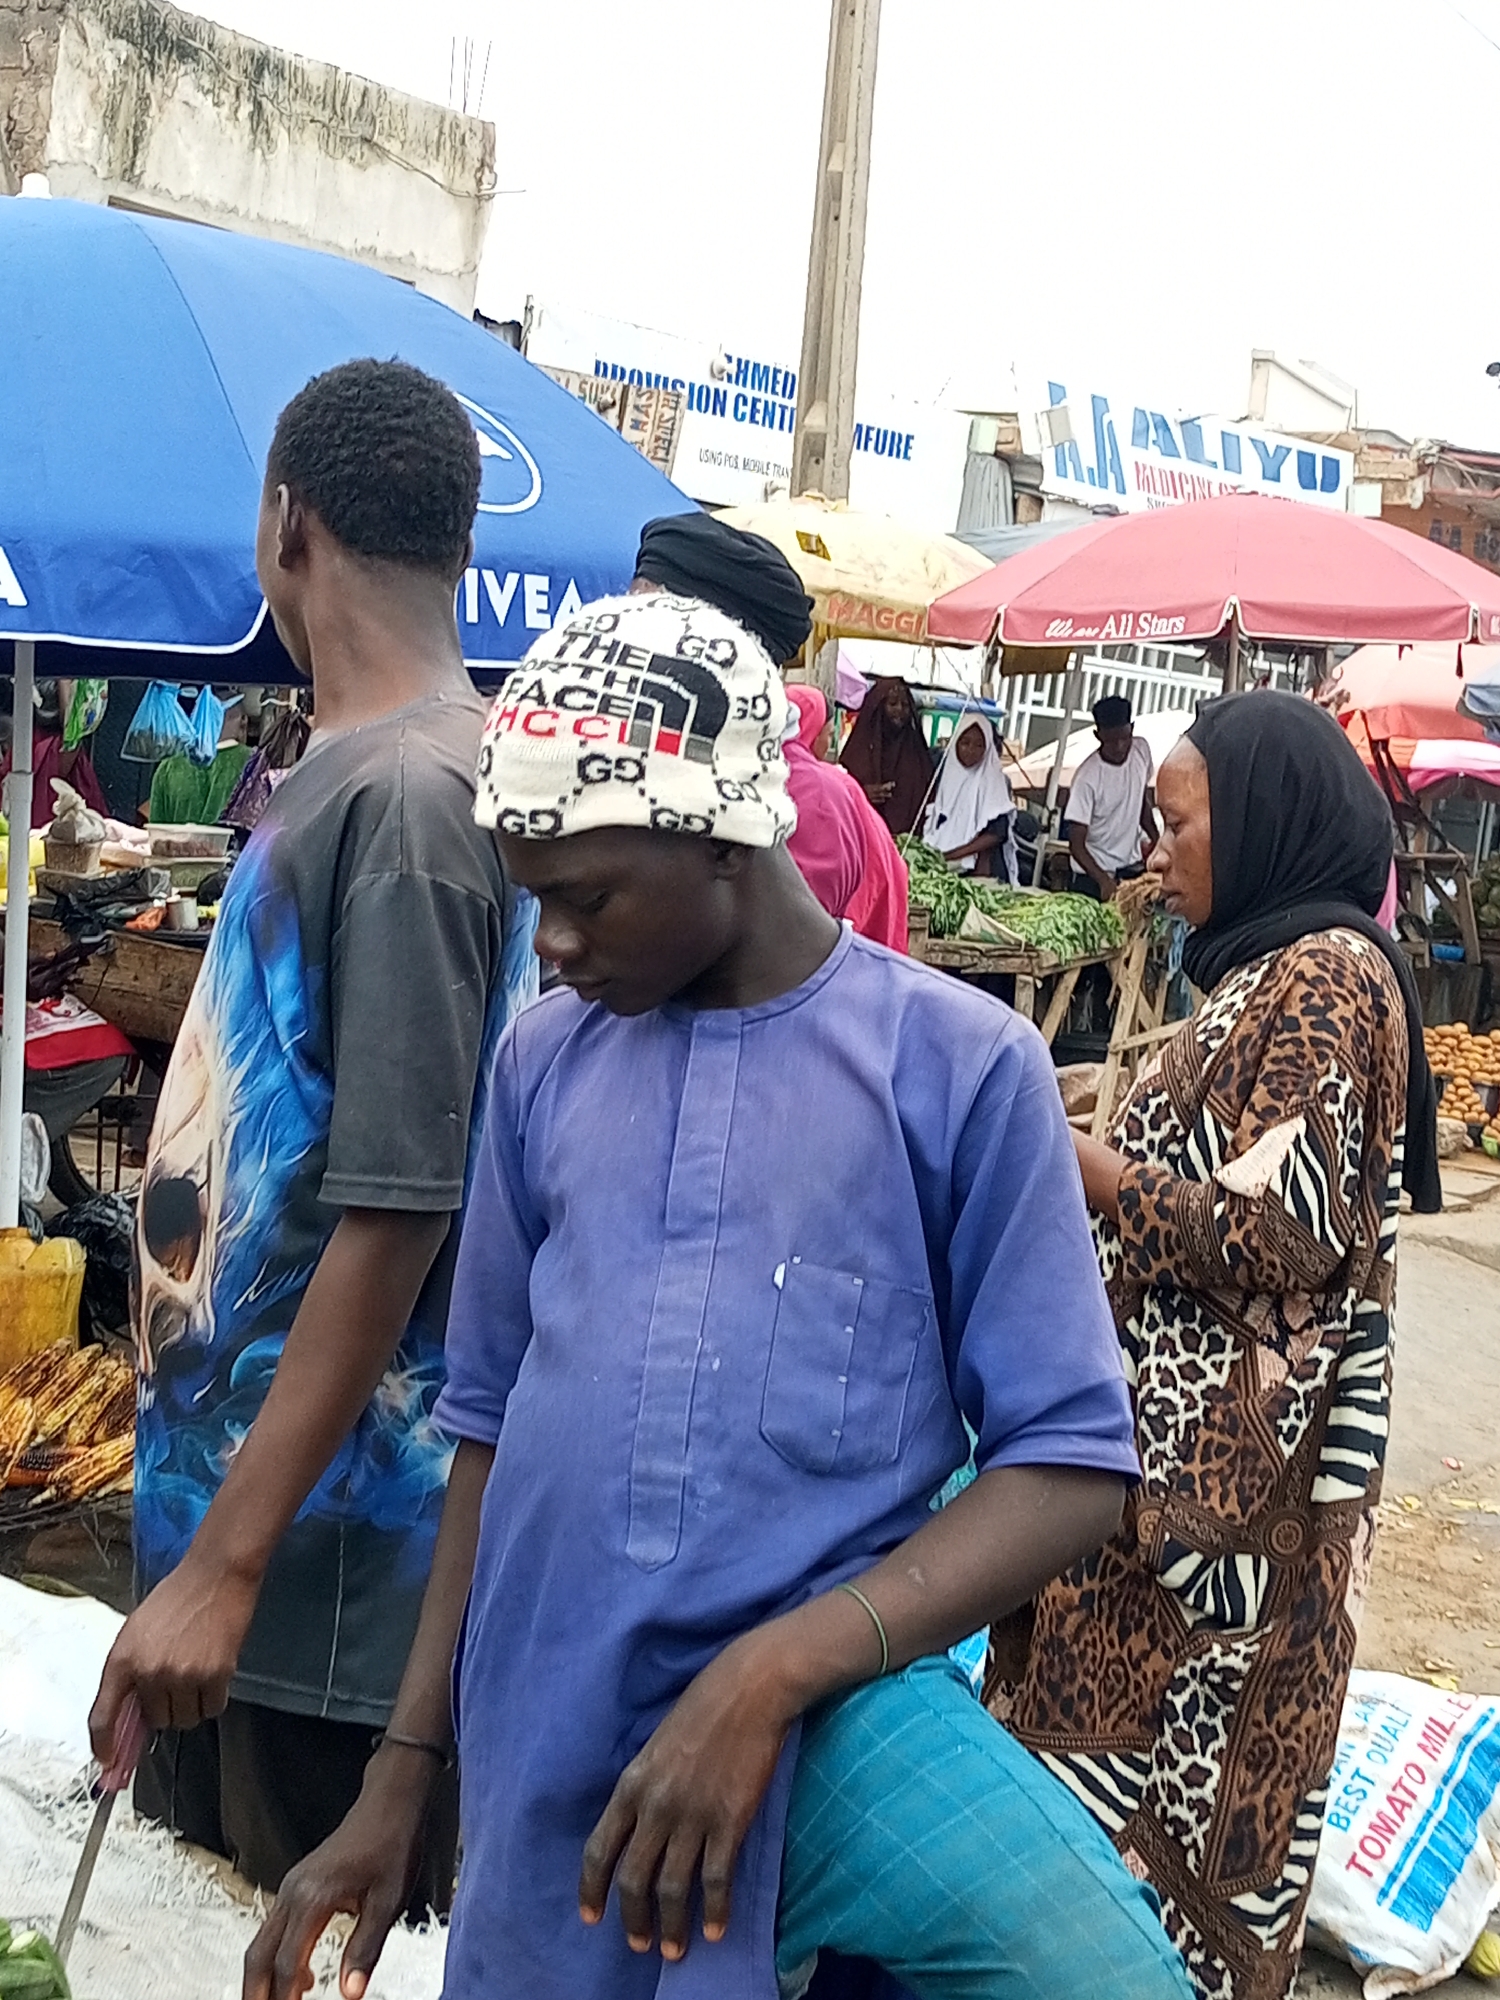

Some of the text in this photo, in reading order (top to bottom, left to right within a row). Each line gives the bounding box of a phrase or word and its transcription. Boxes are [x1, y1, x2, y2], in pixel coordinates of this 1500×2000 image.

[464, 567, 583, 630] IVEA
[827, 596, 924, 637] MAGGI
[1099, 612, 1134, 640] All
[1135, 611, 1187, 638] Stars
[554, 630, 651, 671] THE
[502, 676, 634, 719] FACE
[1326, 1766, 1376, 1833] BEST
[1345, 1762, 1427, 1878] TOMATO
